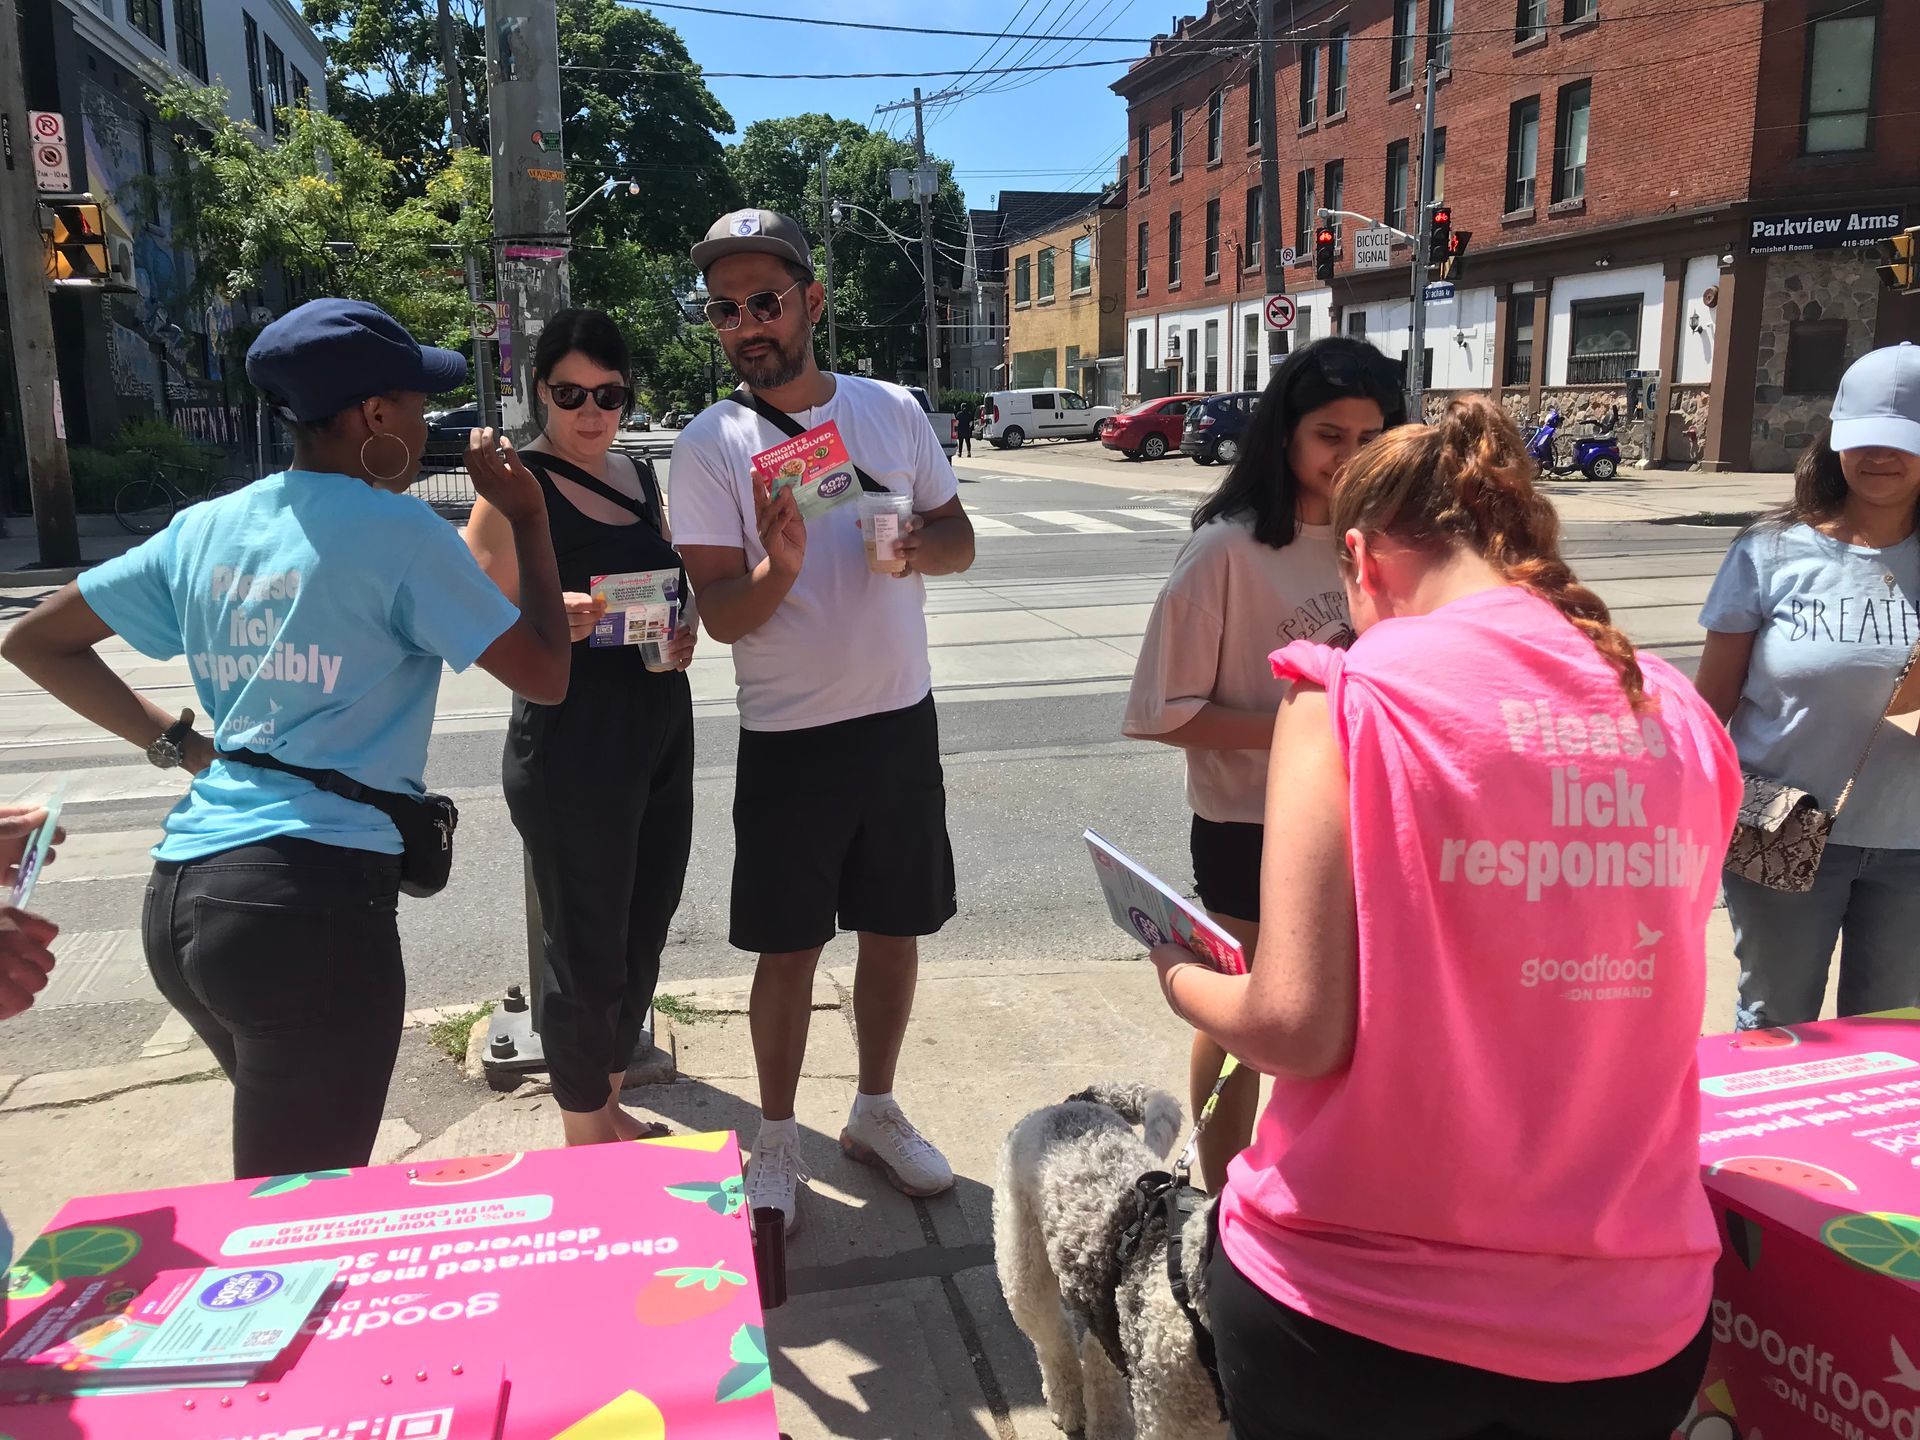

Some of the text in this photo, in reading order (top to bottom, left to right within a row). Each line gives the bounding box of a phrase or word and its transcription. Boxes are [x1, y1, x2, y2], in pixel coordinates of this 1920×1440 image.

[738, 218, 752, 236] 6
[1752, 213, 1899, 238] Parkview Arms
[1356, 233, 1389, 248] BICYCLE
[1750, 245, 1787, 254] Furnished
[1842, 238, 1888, 248] 416-504-
[1357, 250, 1388, 263] SIGNAL
[1425, 289, 1445, 299] Sachan
[758, 436, 808, 464] TONIGHT'S
[760, 432, 835, 469] DINNER SOLVED.
[820, 473, 847, 492] 50%
[230, 608, 283, 647] lick
[1276, 591, 1348, 642] CALIF
[1791, 597, 1920, 645] BREATH
[1501, 698, 1668, 758] Please
[1552, 765, 1648, 827] lick
[1520, 953, 1656, 988] goodfood
[1571, 986, 1653, 1001] ON DEMAND
[277, 1203, 505, 1236] WITH CODE POPTAIL50
[322, 1225, 380, 1240] FIRST
[387, 1218, 437, 1233] YOUR
[441, 1213, 478, 1226] OFF
[248, 1232, 318, 1249] ORDER
[428, 1226, 602, 1261] delivered
[386, 1246, 423, 1264] in
[434, 1236, 679, 1280] Chef-curated
[369, 1293, 418, 1308] ON
[303, 1291, 501, 1340] goodfo
[1712, 1298, 1920, 1440] goodfood
[1774, 1377, 1807, 1412] ON
